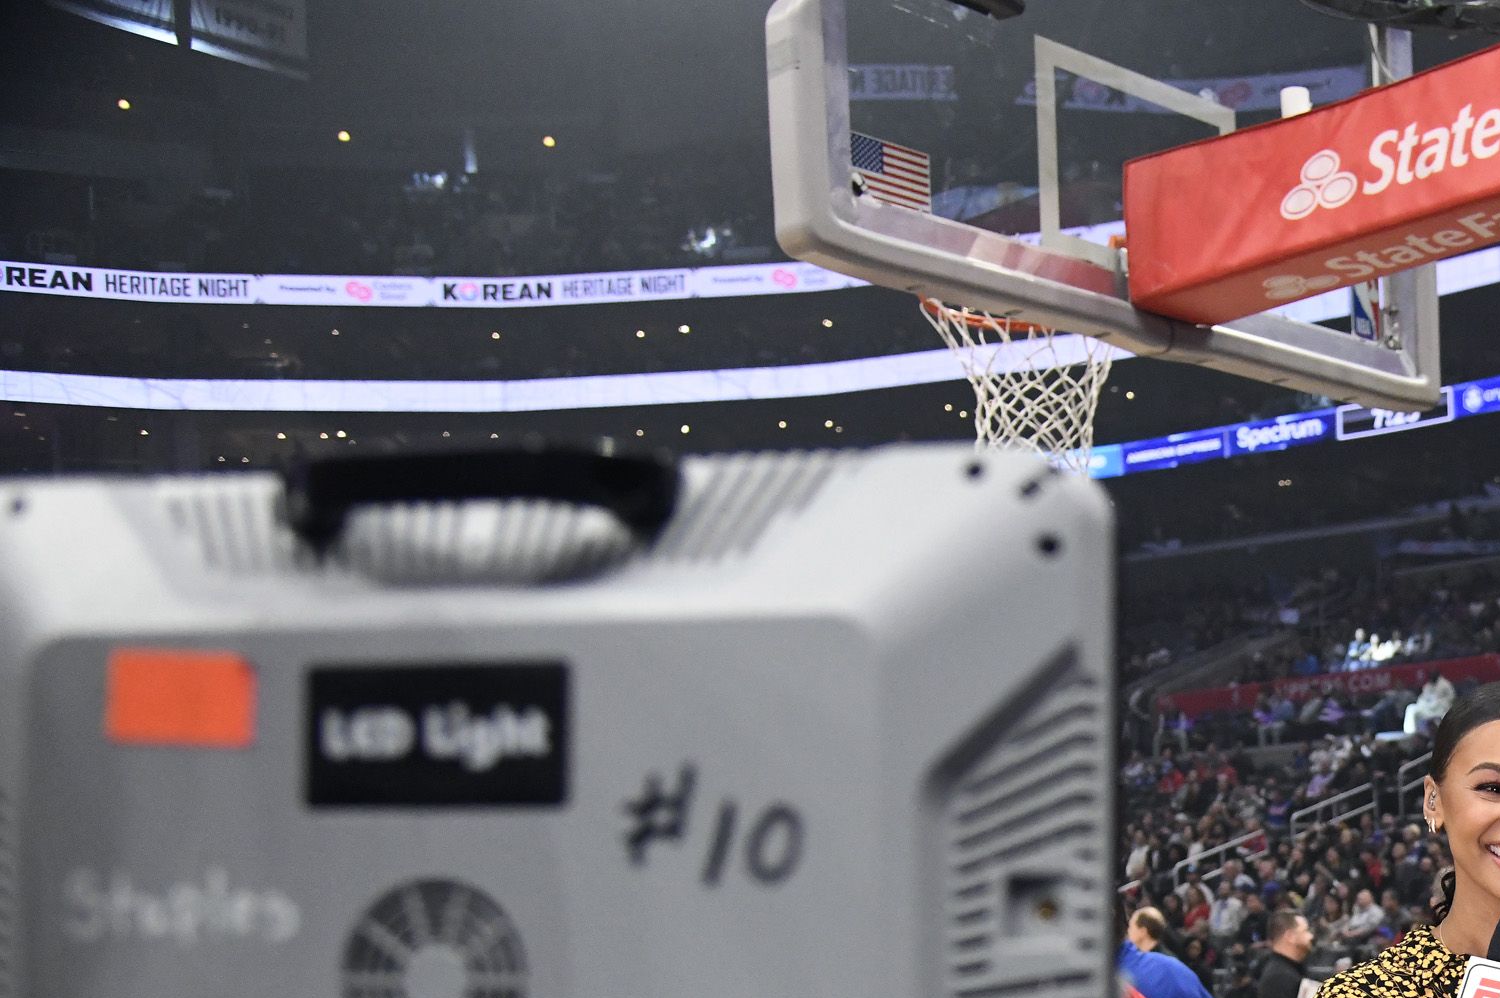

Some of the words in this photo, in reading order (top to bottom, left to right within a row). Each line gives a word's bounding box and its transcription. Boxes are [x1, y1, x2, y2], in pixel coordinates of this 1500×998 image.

[0, 266, 93, 292] REAN
[105, 273, 192, 297] HERITAGE
[199, 278, 250, 299] NIGHT
[562, 277, 634, 300] HERITAGE
[640, 273, 686, 296] NIGHT
[1236, 416, 1324, 449] Spectrum
[422, 699, 551, 772] Light
[622, 762, 805, 887] #10
